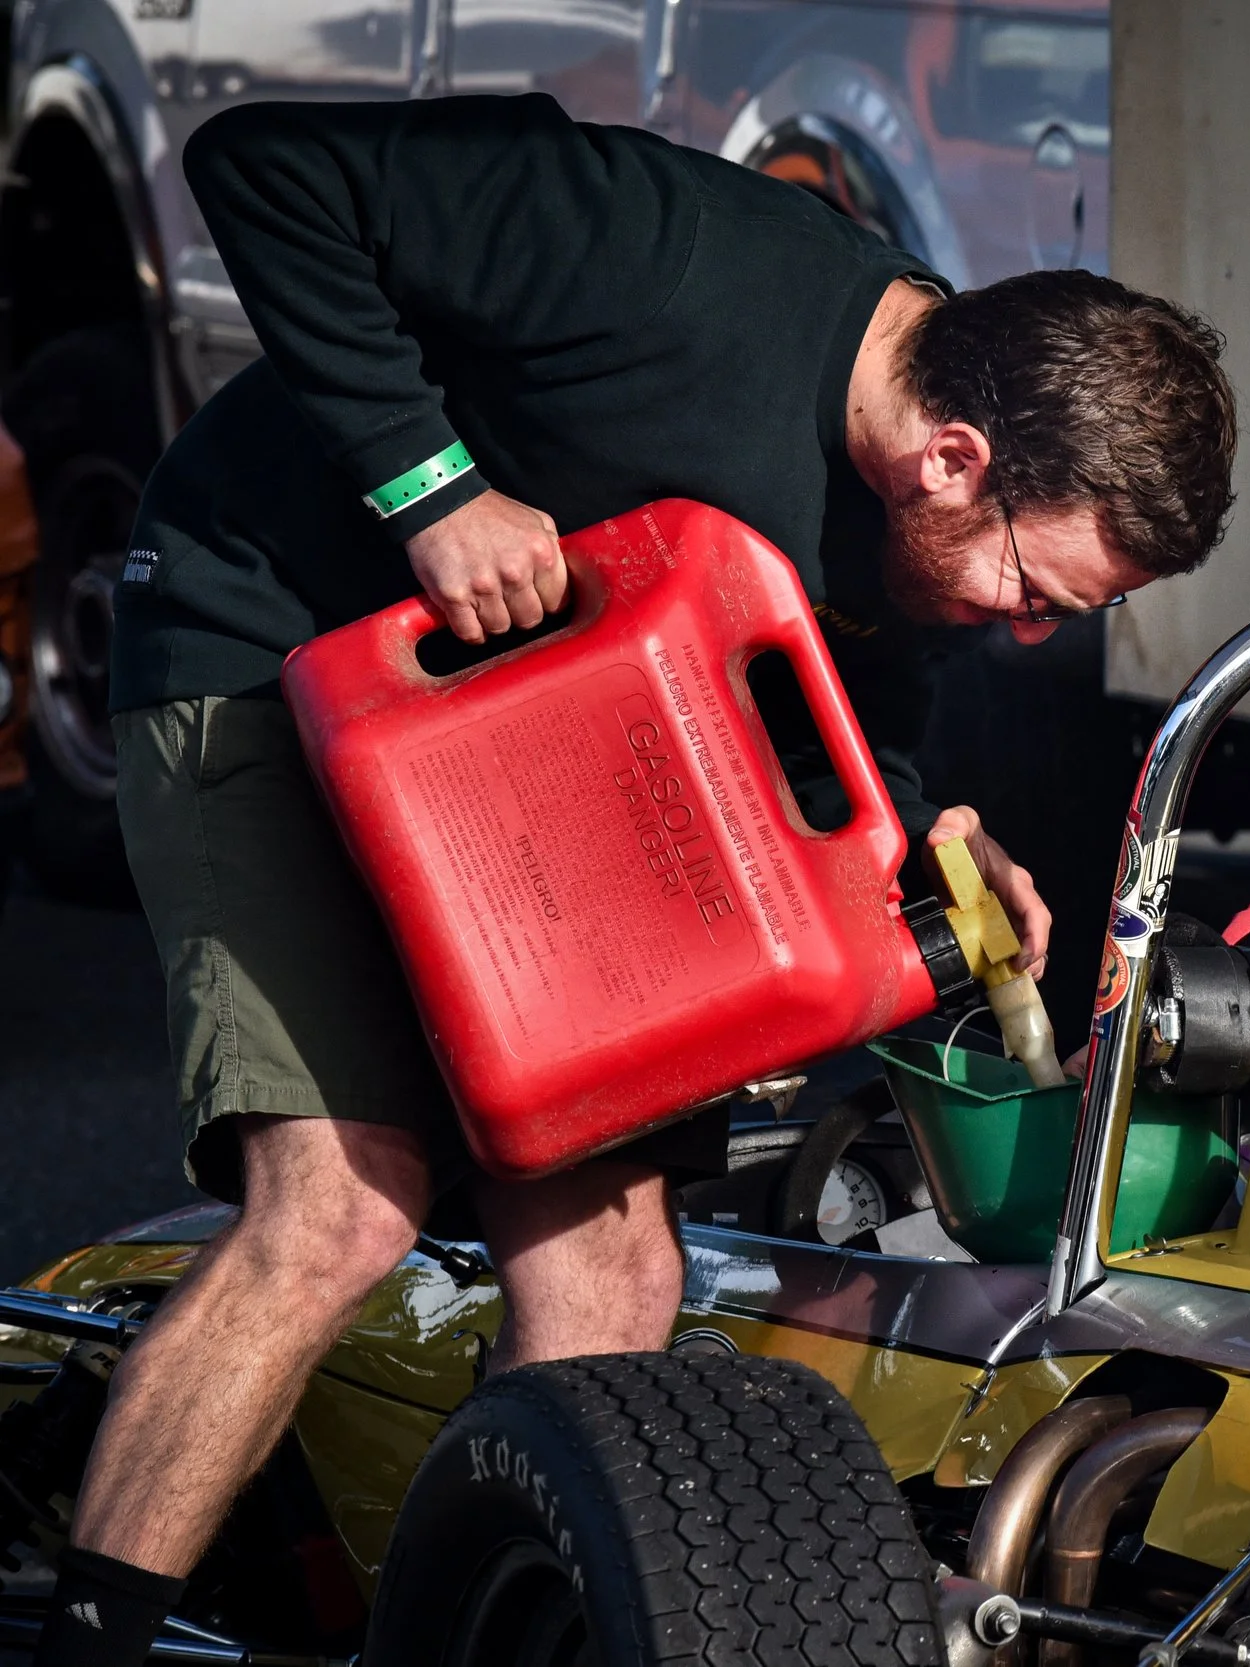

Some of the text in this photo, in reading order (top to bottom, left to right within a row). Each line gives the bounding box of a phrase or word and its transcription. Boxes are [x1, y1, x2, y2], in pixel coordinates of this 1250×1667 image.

[614, 766, 687, 899] DANGER!
[627, 719, 735, 924] GASOLINE
[654, 647, 789, 945] PELIGRO EXTREMADAMENTE FLAMABLE
[681, 643, 716, 708] DANGER
[757, 822, 812, 933] INFLAMMABLE
[855, 1216, 869, 1229] 10
